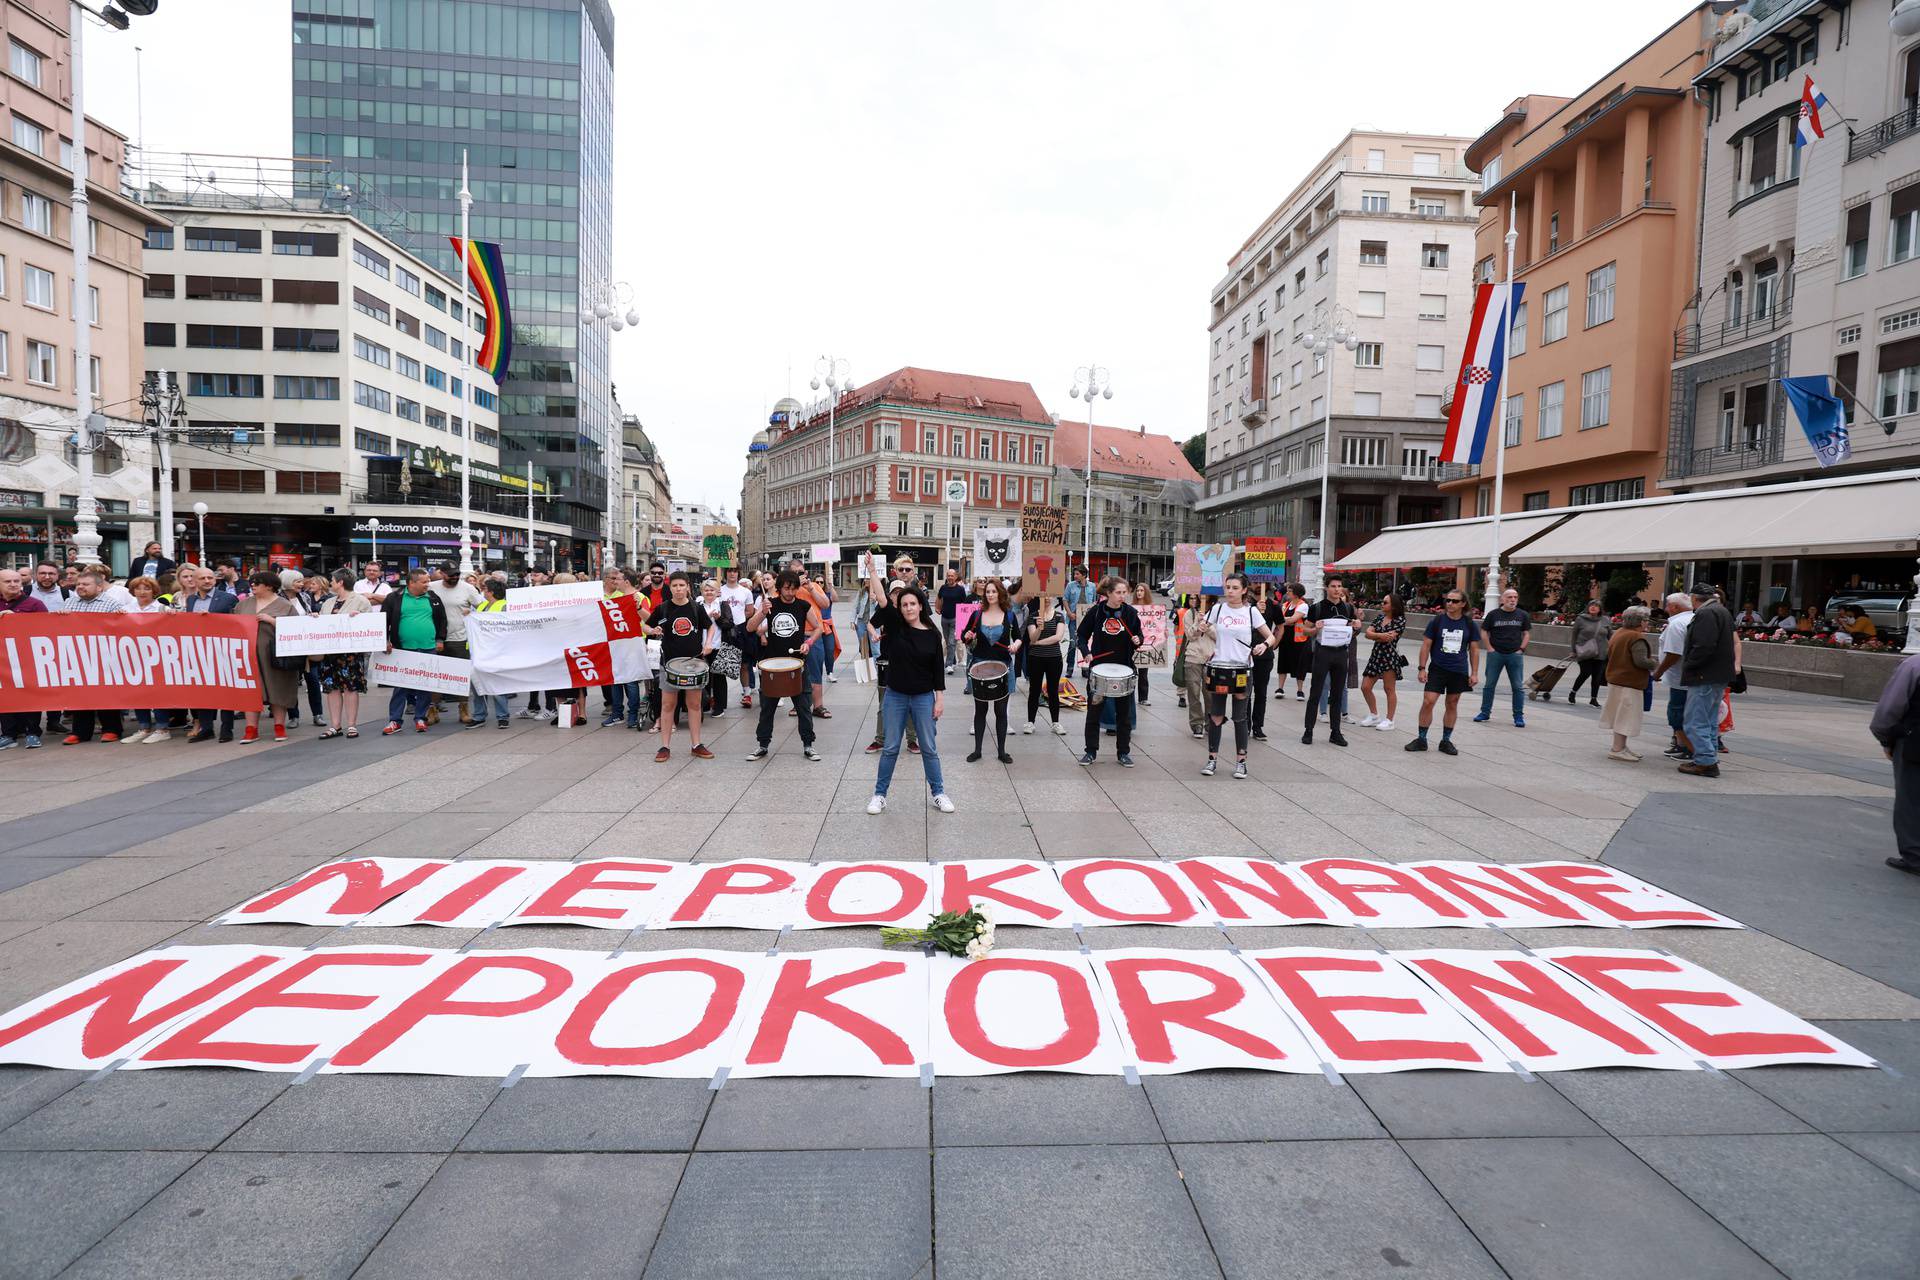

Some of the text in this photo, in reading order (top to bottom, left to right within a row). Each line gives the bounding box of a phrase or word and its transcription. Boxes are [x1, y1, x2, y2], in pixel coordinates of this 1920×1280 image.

[352, 522, 419, 532] Jedostavno
[422, 525, 449, 535] puno
[1023, 518, 1063, 532] EMPATIJA
[509, 602, 532, 611] Zagreb
[279, 634, 303, 642] Zagreb
[5, 635, 256, 689] I RAVNOPRAVNE!
[374, 662, 468, 683] Zagreb #SafePlace4Women
[568, 647, 599, 681] SDP
[241, 859, 1720, 923] NIEPOKONANE
[0, 954, 1839, 1067] NEPOKORENE
